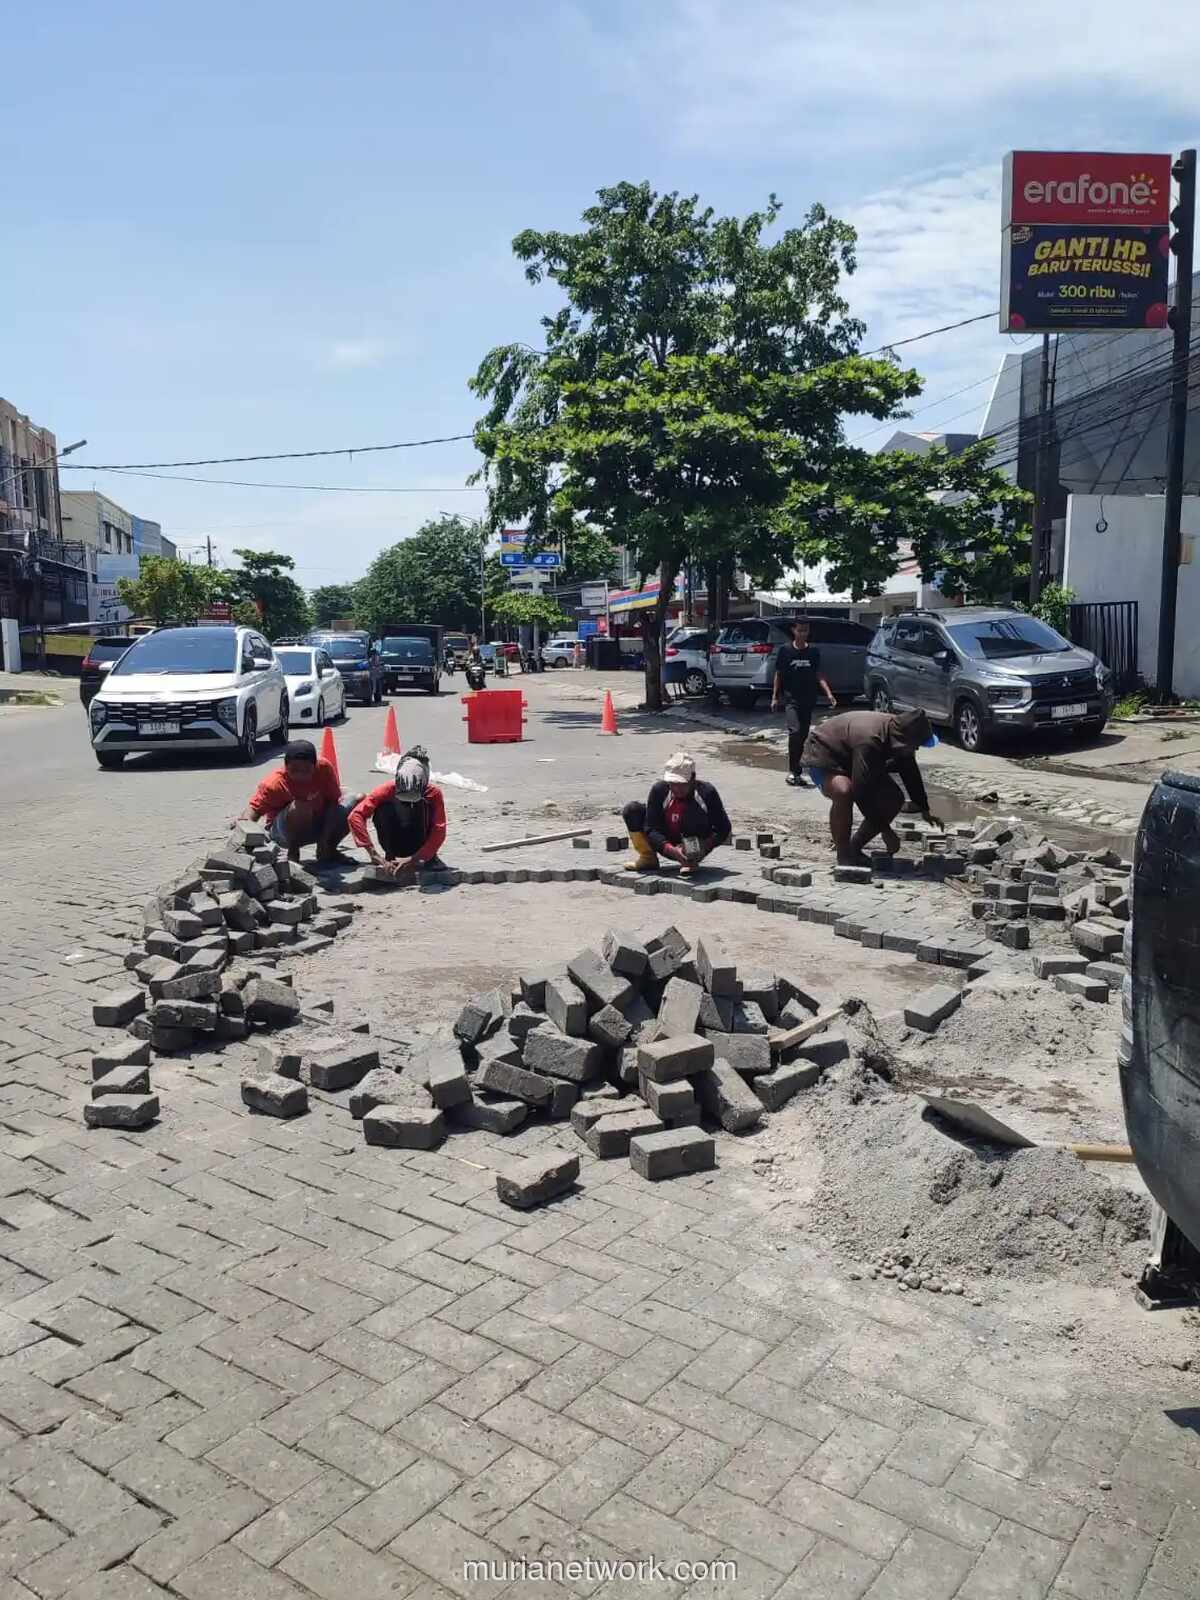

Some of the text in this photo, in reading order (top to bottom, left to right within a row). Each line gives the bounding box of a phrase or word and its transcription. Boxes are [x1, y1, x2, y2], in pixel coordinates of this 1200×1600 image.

[1023, 174, 1151, 205] erafone
[1034, 236, 1147, 261] GANTI HP
[1027, 258, 1152, 278] BARU TERUSSS!!
[1058, 285, 1087, 298] 300
[1089, 285, 1116, 298] ribu
